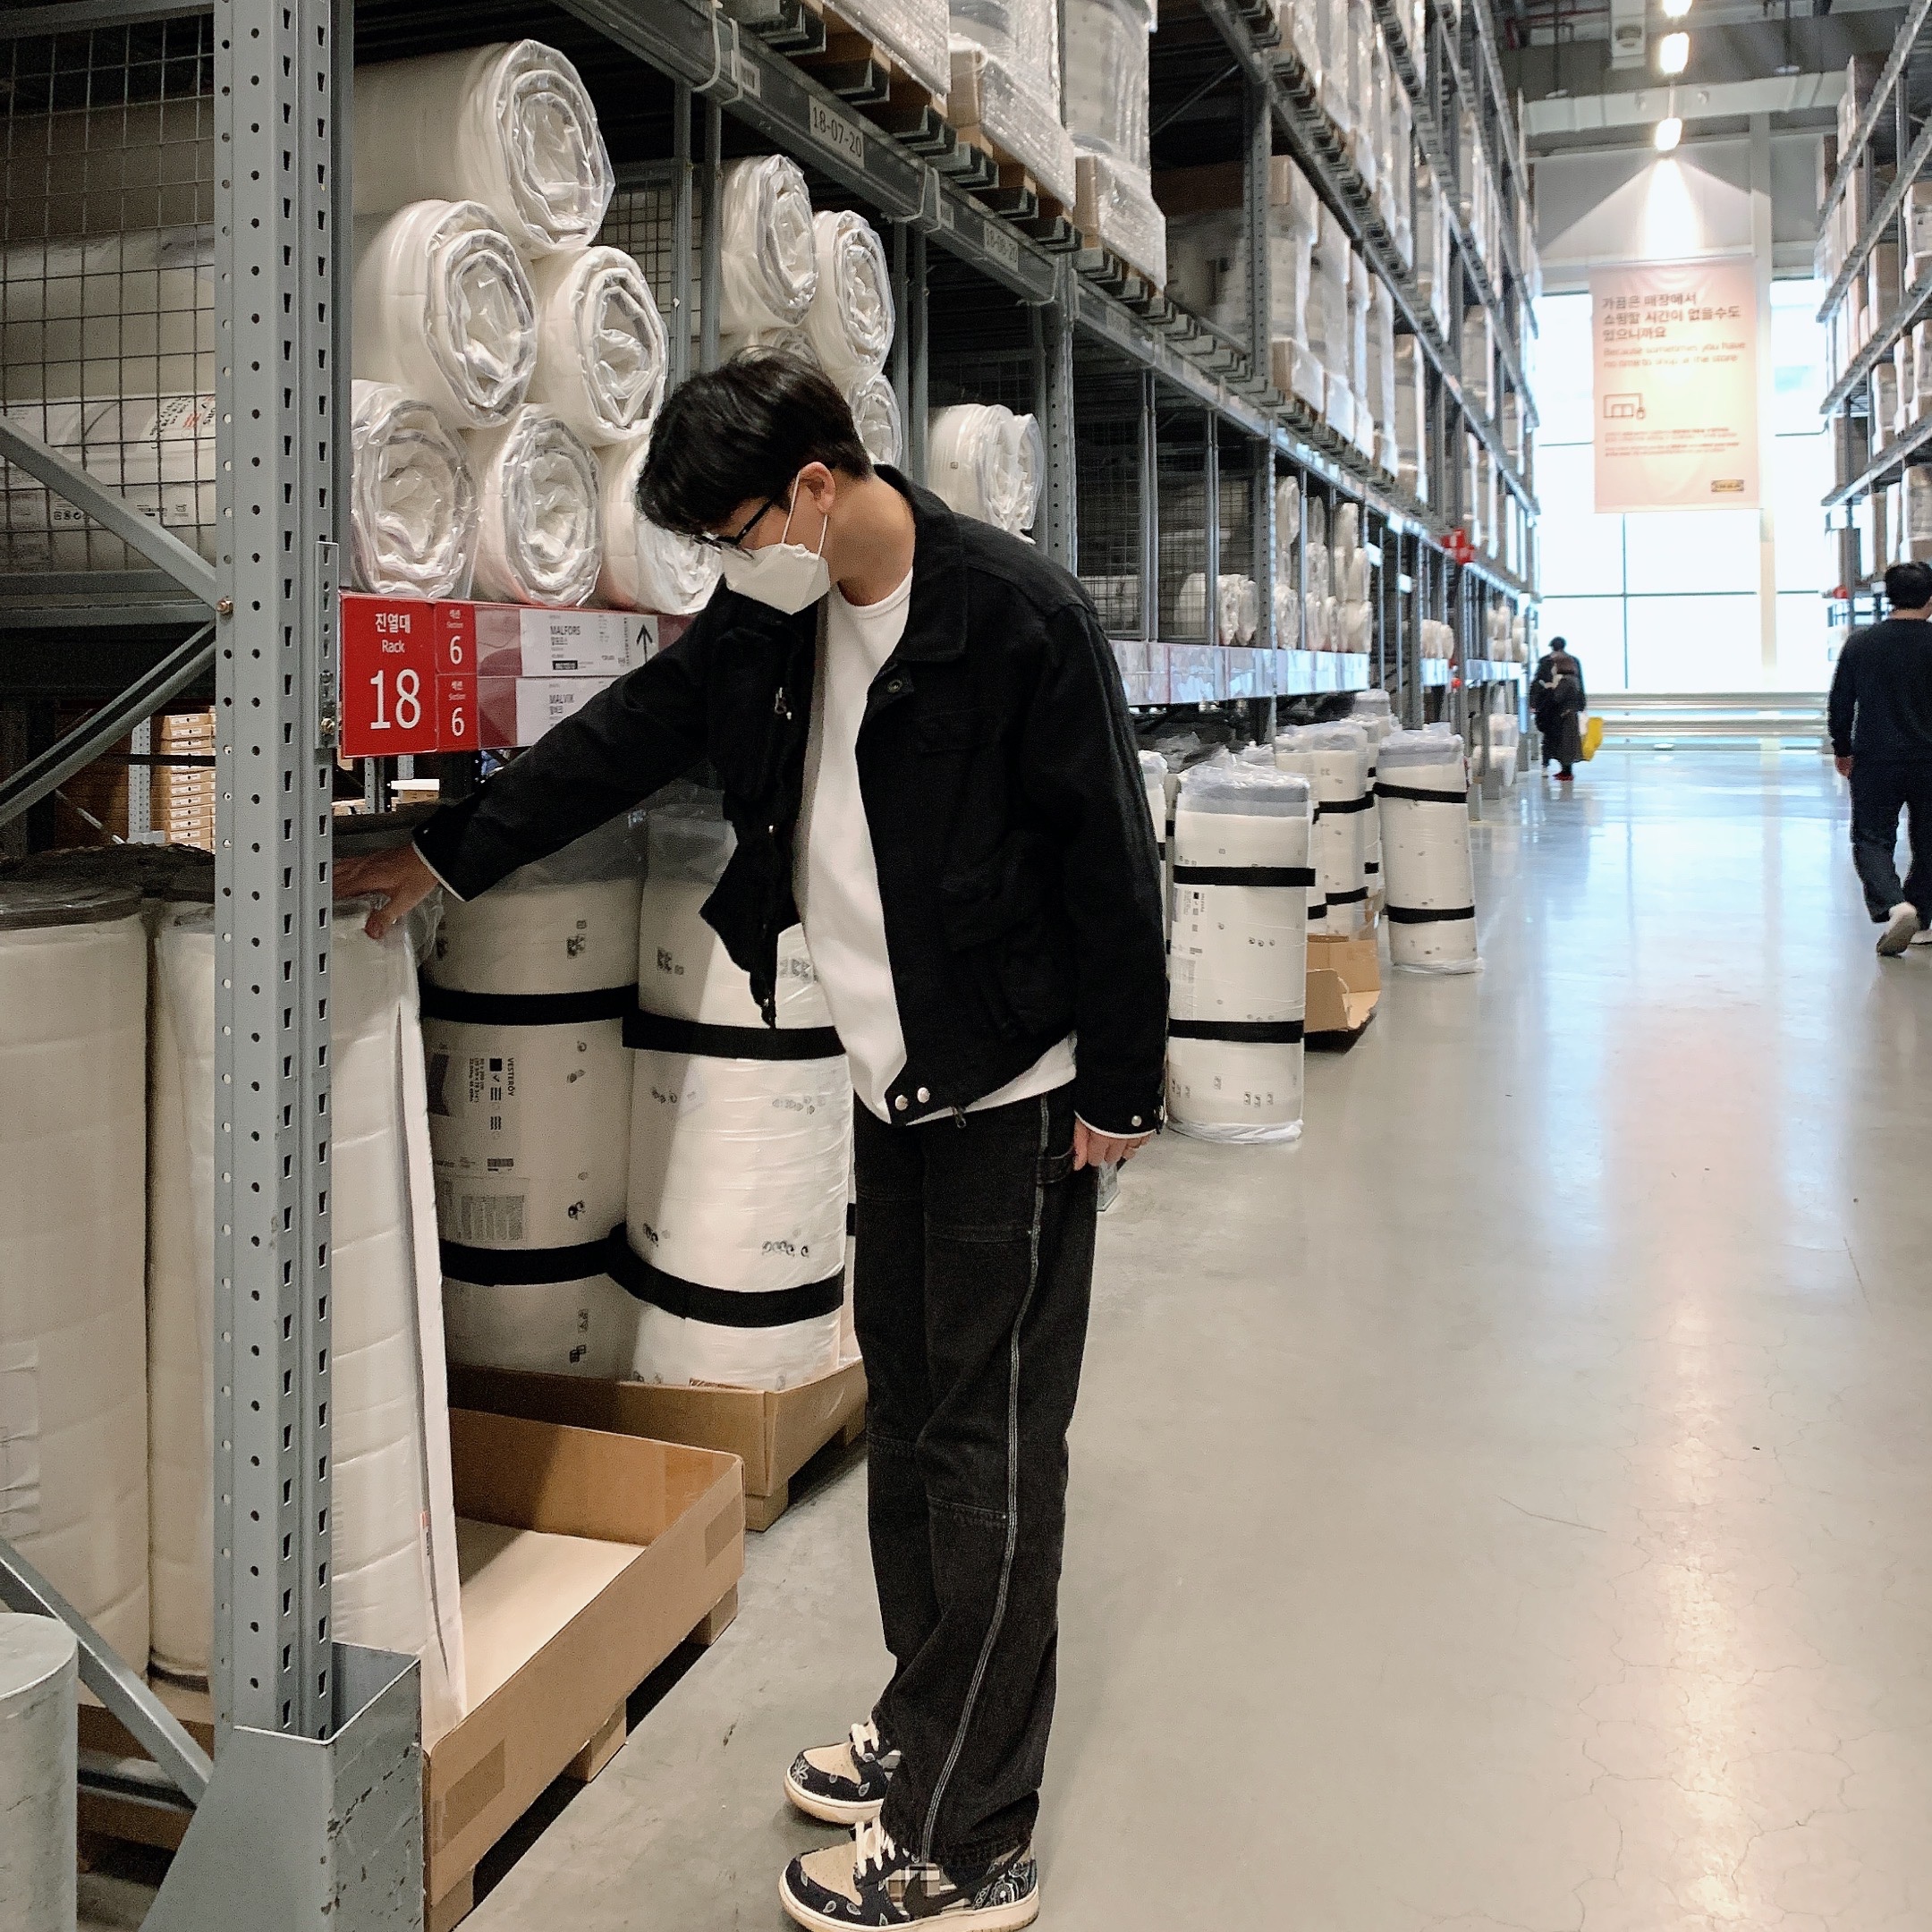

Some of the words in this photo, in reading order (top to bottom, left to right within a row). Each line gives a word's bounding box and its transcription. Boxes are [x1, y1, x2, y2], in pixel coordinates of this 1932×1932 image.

[812, 106, 862, 157] 18-07-20
[1644, 292, 1697, 306] 매장에서
[1645, 309, 1682, 323] 시간이
[375, 613, 411, 633] 진열대
[550, 625, 580, 636] MALFORS
[382, 640, 405, 653] Rack
[450, 635, 462, 665] 6
[369, 668, 421, 729] 18
[549, 693, 574, 704] MALVIK
[452, 707, 465, 737] 6
